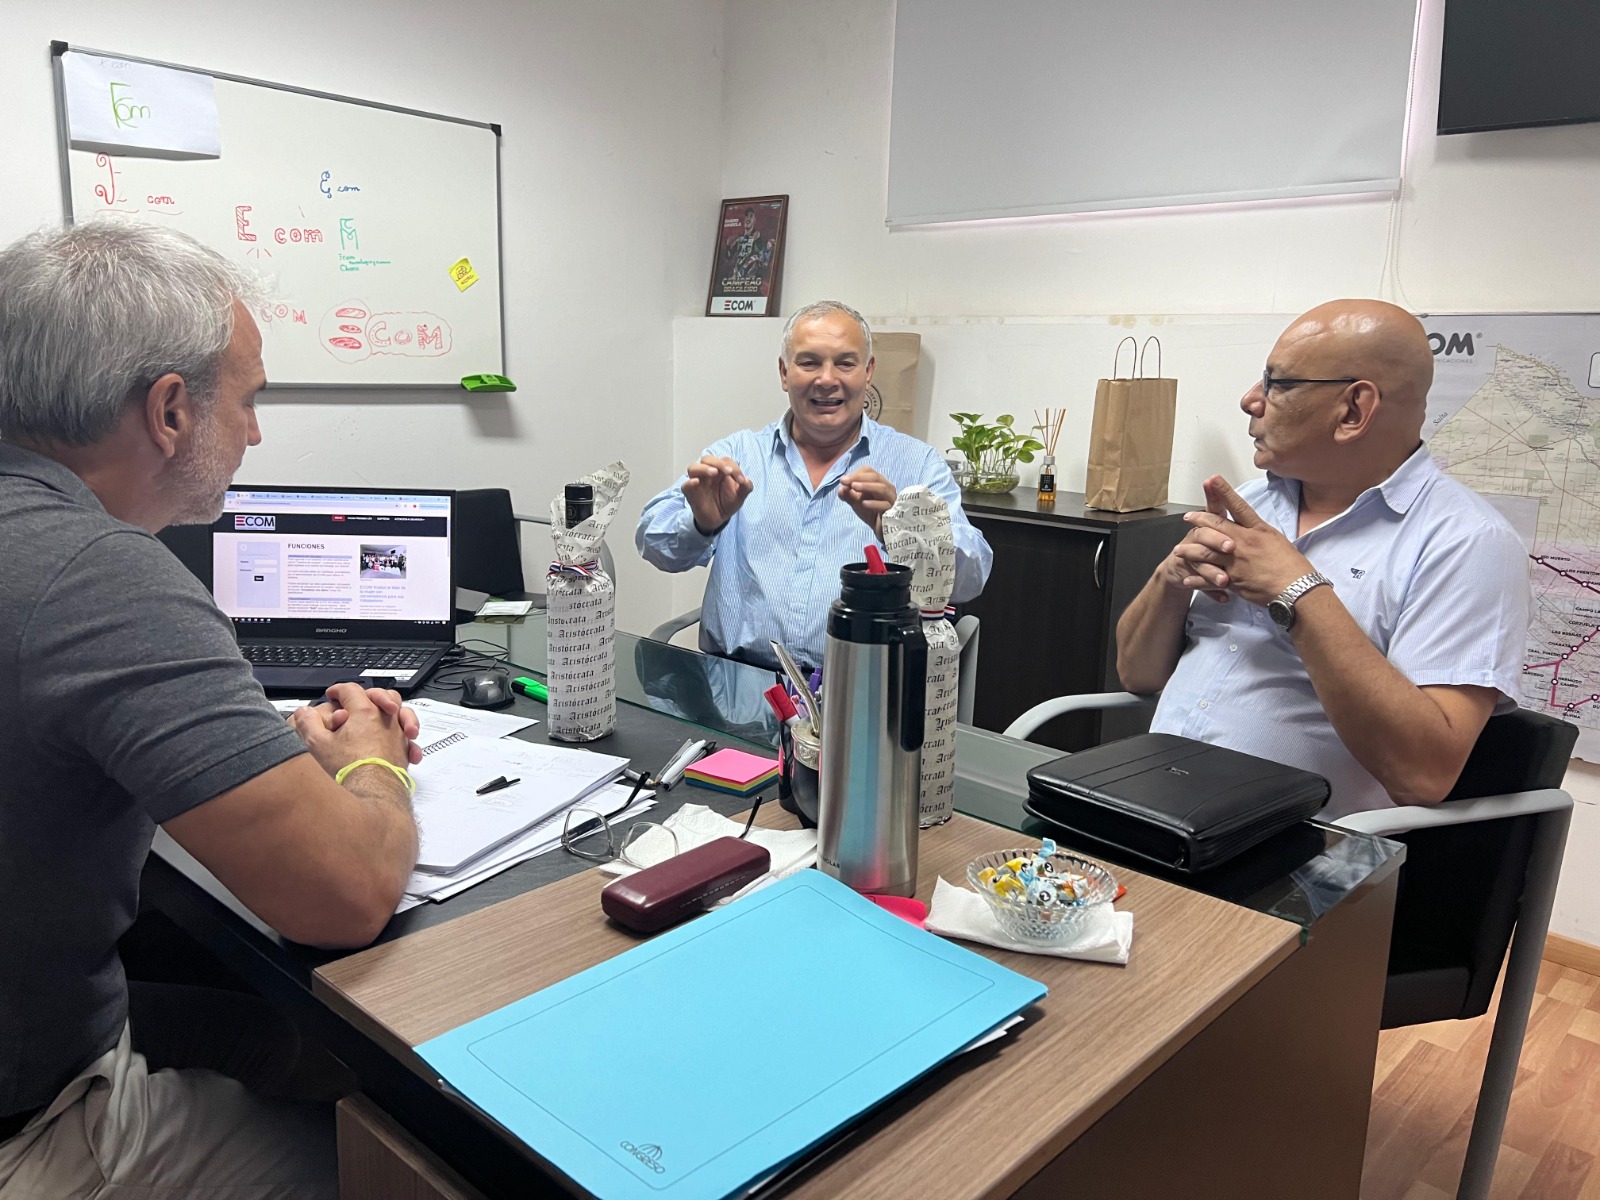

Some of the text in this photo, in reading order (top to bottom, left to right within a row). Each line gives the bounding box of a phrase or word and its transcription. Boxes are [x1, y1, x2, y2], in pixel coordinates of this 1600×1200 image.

[235, 206, 257, 241] E
[724, 300, 753, 311] ECOM
[1426, 332, 1475, 356] OM
[1432, 411, 1448, 426] Salta
[236, 516, 275, 527] ECOM
[886, 537, 917, 550] stócrata
[569, 598, 602, 610] stócrata
[558, 625, 605, 638] Aristócrata
[549, 643, 590, 653] Aristócrata
[561, 651, 608, 666] Aristócrata
[550, 669, 594, 680] Aristócrata
[565, 677, 611, 694] Aristócrata
[553, 697, 598, 708] Aristócrata
[568, 703, 612, 721] Aristócrata
[556, 723, 601, 735] Aristócrata
[920, 802, 945, 813] ócrata
